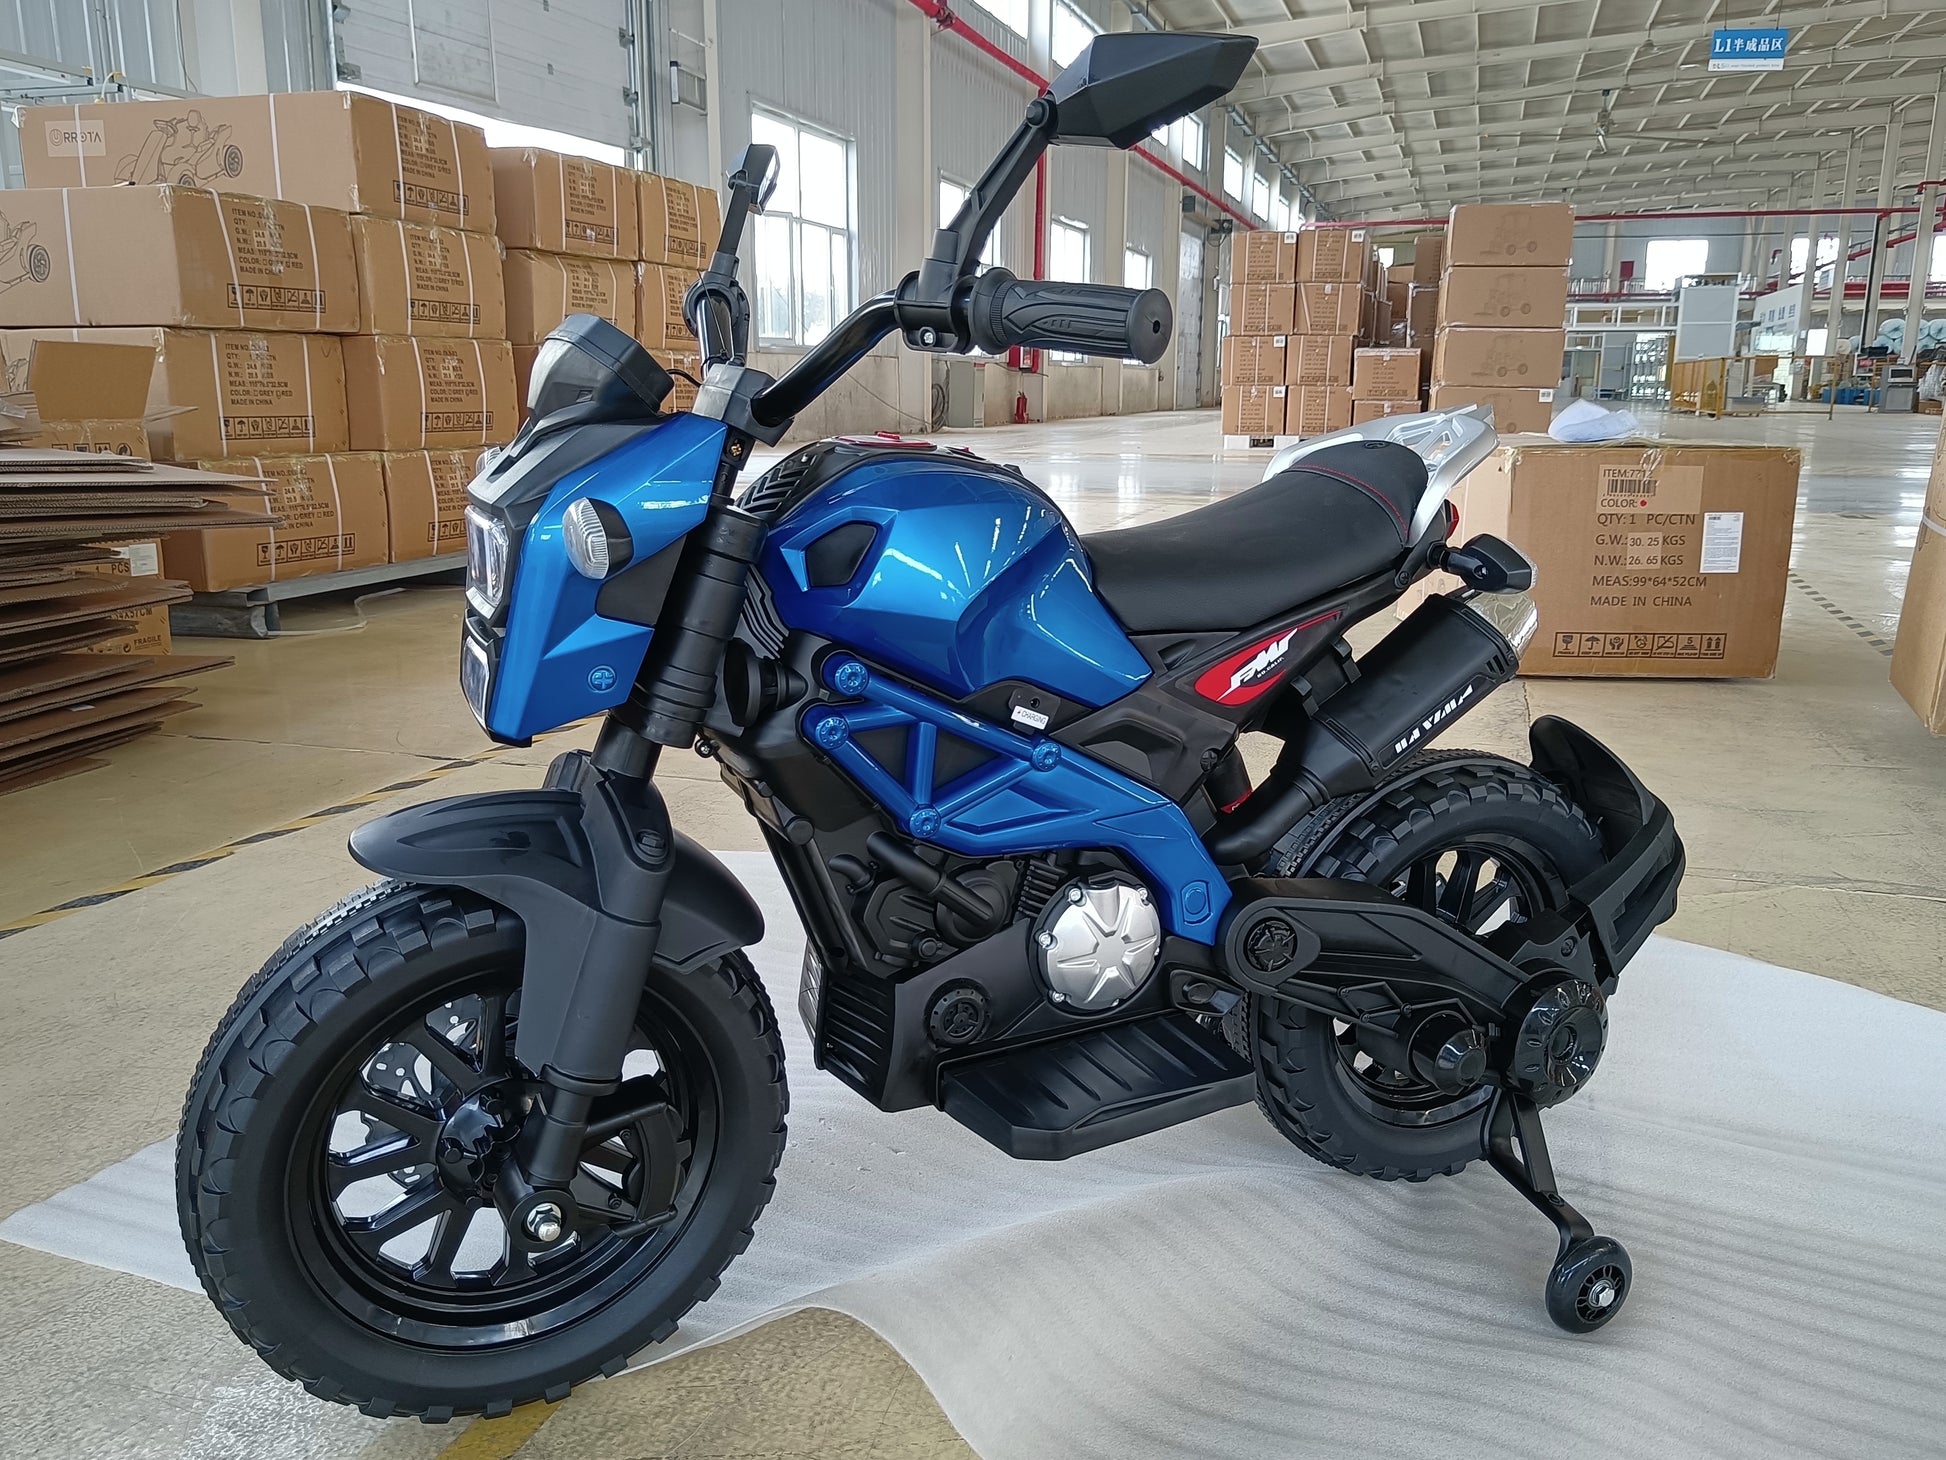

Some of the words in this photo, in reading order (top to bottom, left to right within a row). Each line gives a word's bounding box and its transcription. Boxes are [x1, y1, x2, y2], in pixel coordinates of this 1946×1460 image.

[1714, 38, 1783, 52] L1半成品区
[1600, 499, 1638, 508] COLOR:
[1647, 514, 1695, 525] PC/CTN
[1662, 535, 1686, 545] KGS
[1661, 555, 1683, 566] KGS
[111, 562, 129, 574] PCS
[1590, 596, 1627, 606] MADE
[1633, 596, 1646, 606] IN
[1653, 596, 1692, 607] CHINA
